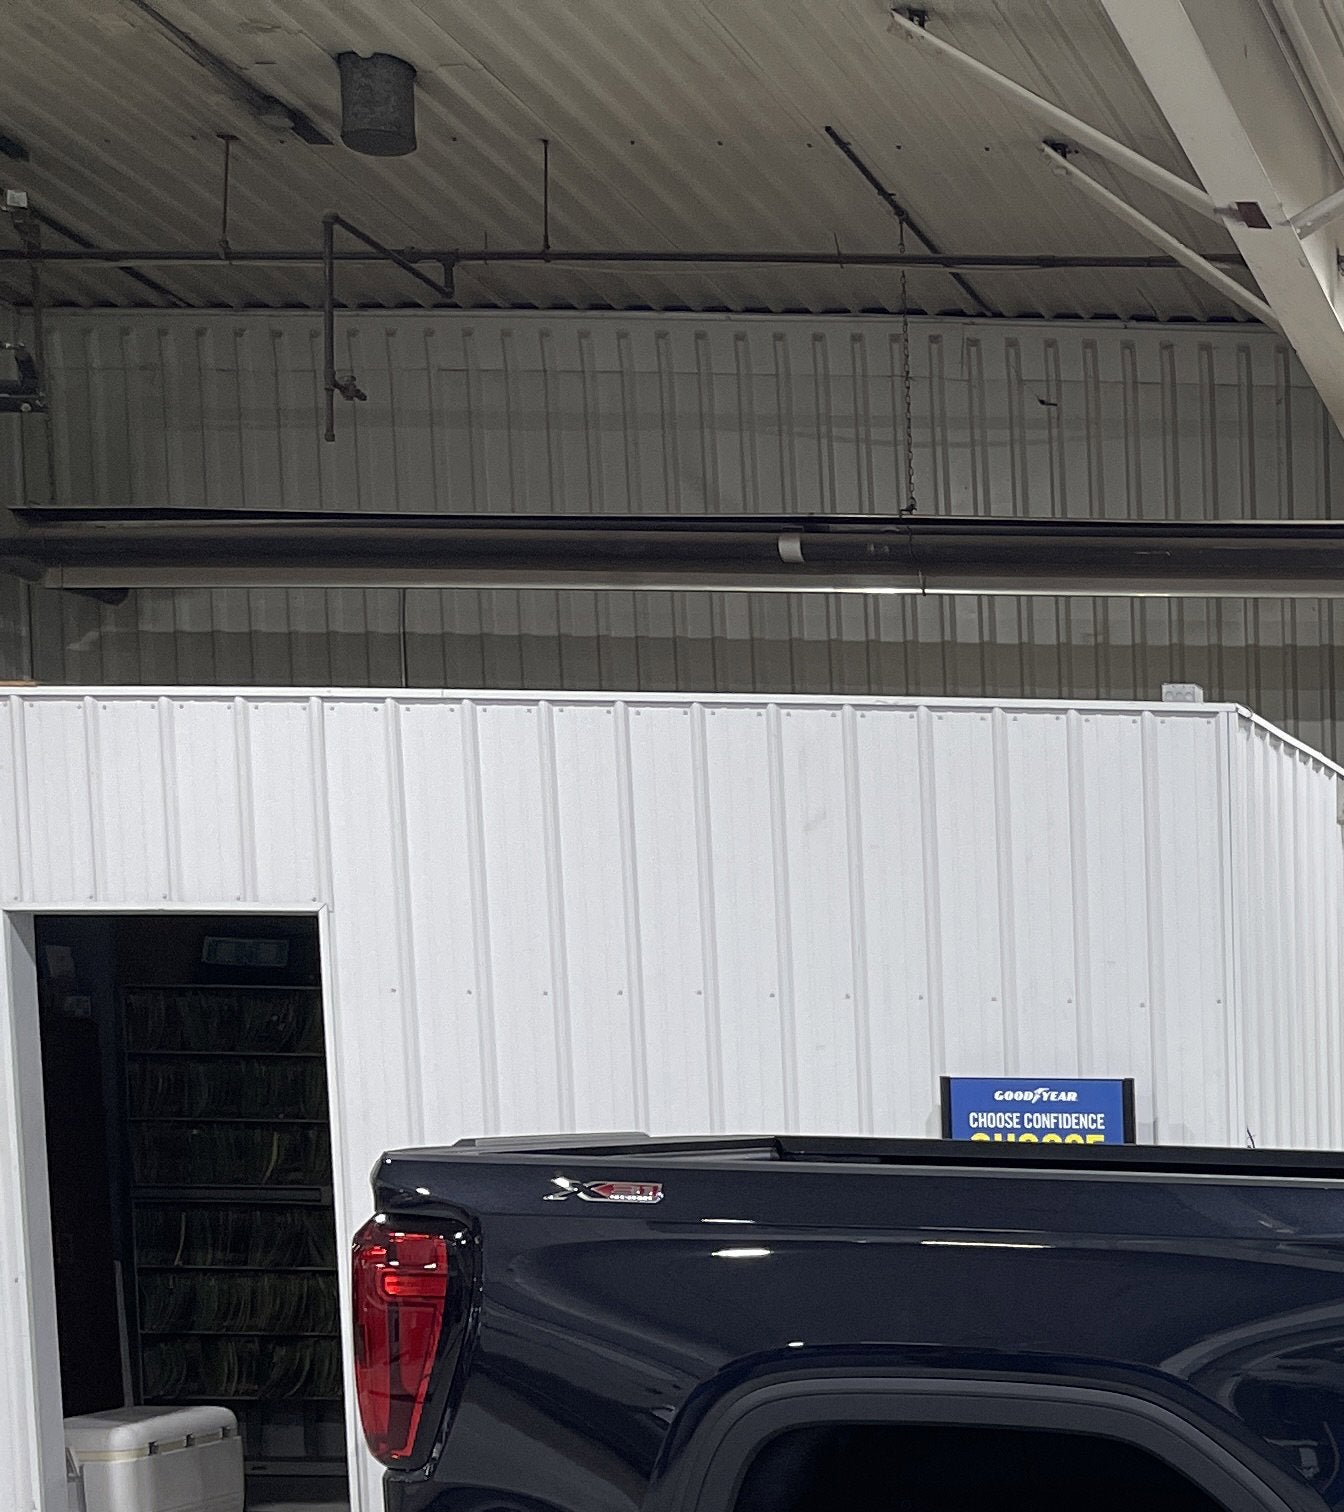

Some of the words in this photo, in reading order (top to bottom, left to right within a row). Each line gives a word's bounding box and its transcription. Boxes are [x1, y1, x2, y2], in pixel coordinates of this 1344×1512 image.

[994, 1088, 1077, 1103] GOODYEAR
[969, 1112, 1021, 1129] CHOOSE
[1023, 1112, 1105, 1129] CONFIDENCE
